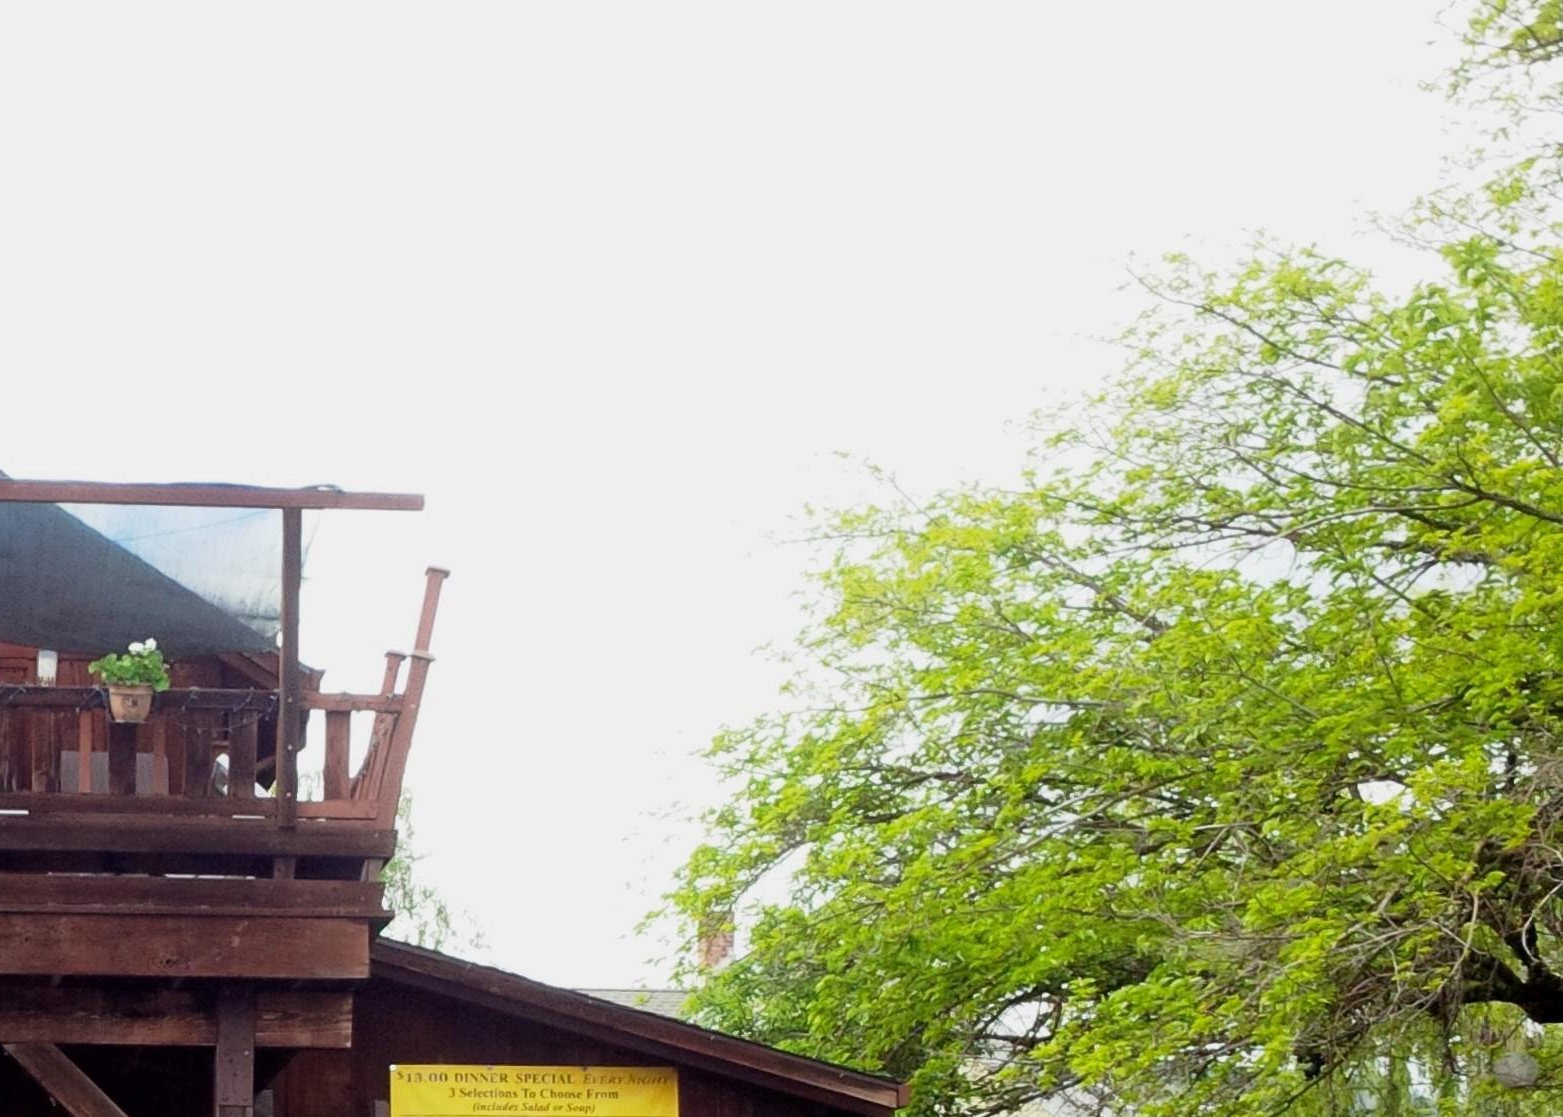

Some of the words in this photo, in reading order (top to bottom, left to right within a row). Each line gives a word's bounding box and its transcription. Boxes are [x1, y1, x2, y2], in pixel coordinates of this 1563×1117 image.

[454, 1073, 509, 1084] DINNER
[515, 1073, 575, 1085] SPECIAL
[448, 1087, 456, 1099] 3
[459, 1087, 519, 1099] Selections
[521, 1088, 537, 1099] To
[539, 1088, 584, 1100] Choose
[586, 1089, 620, 1100] From
[521, 1102, 550, 1112] Salad
